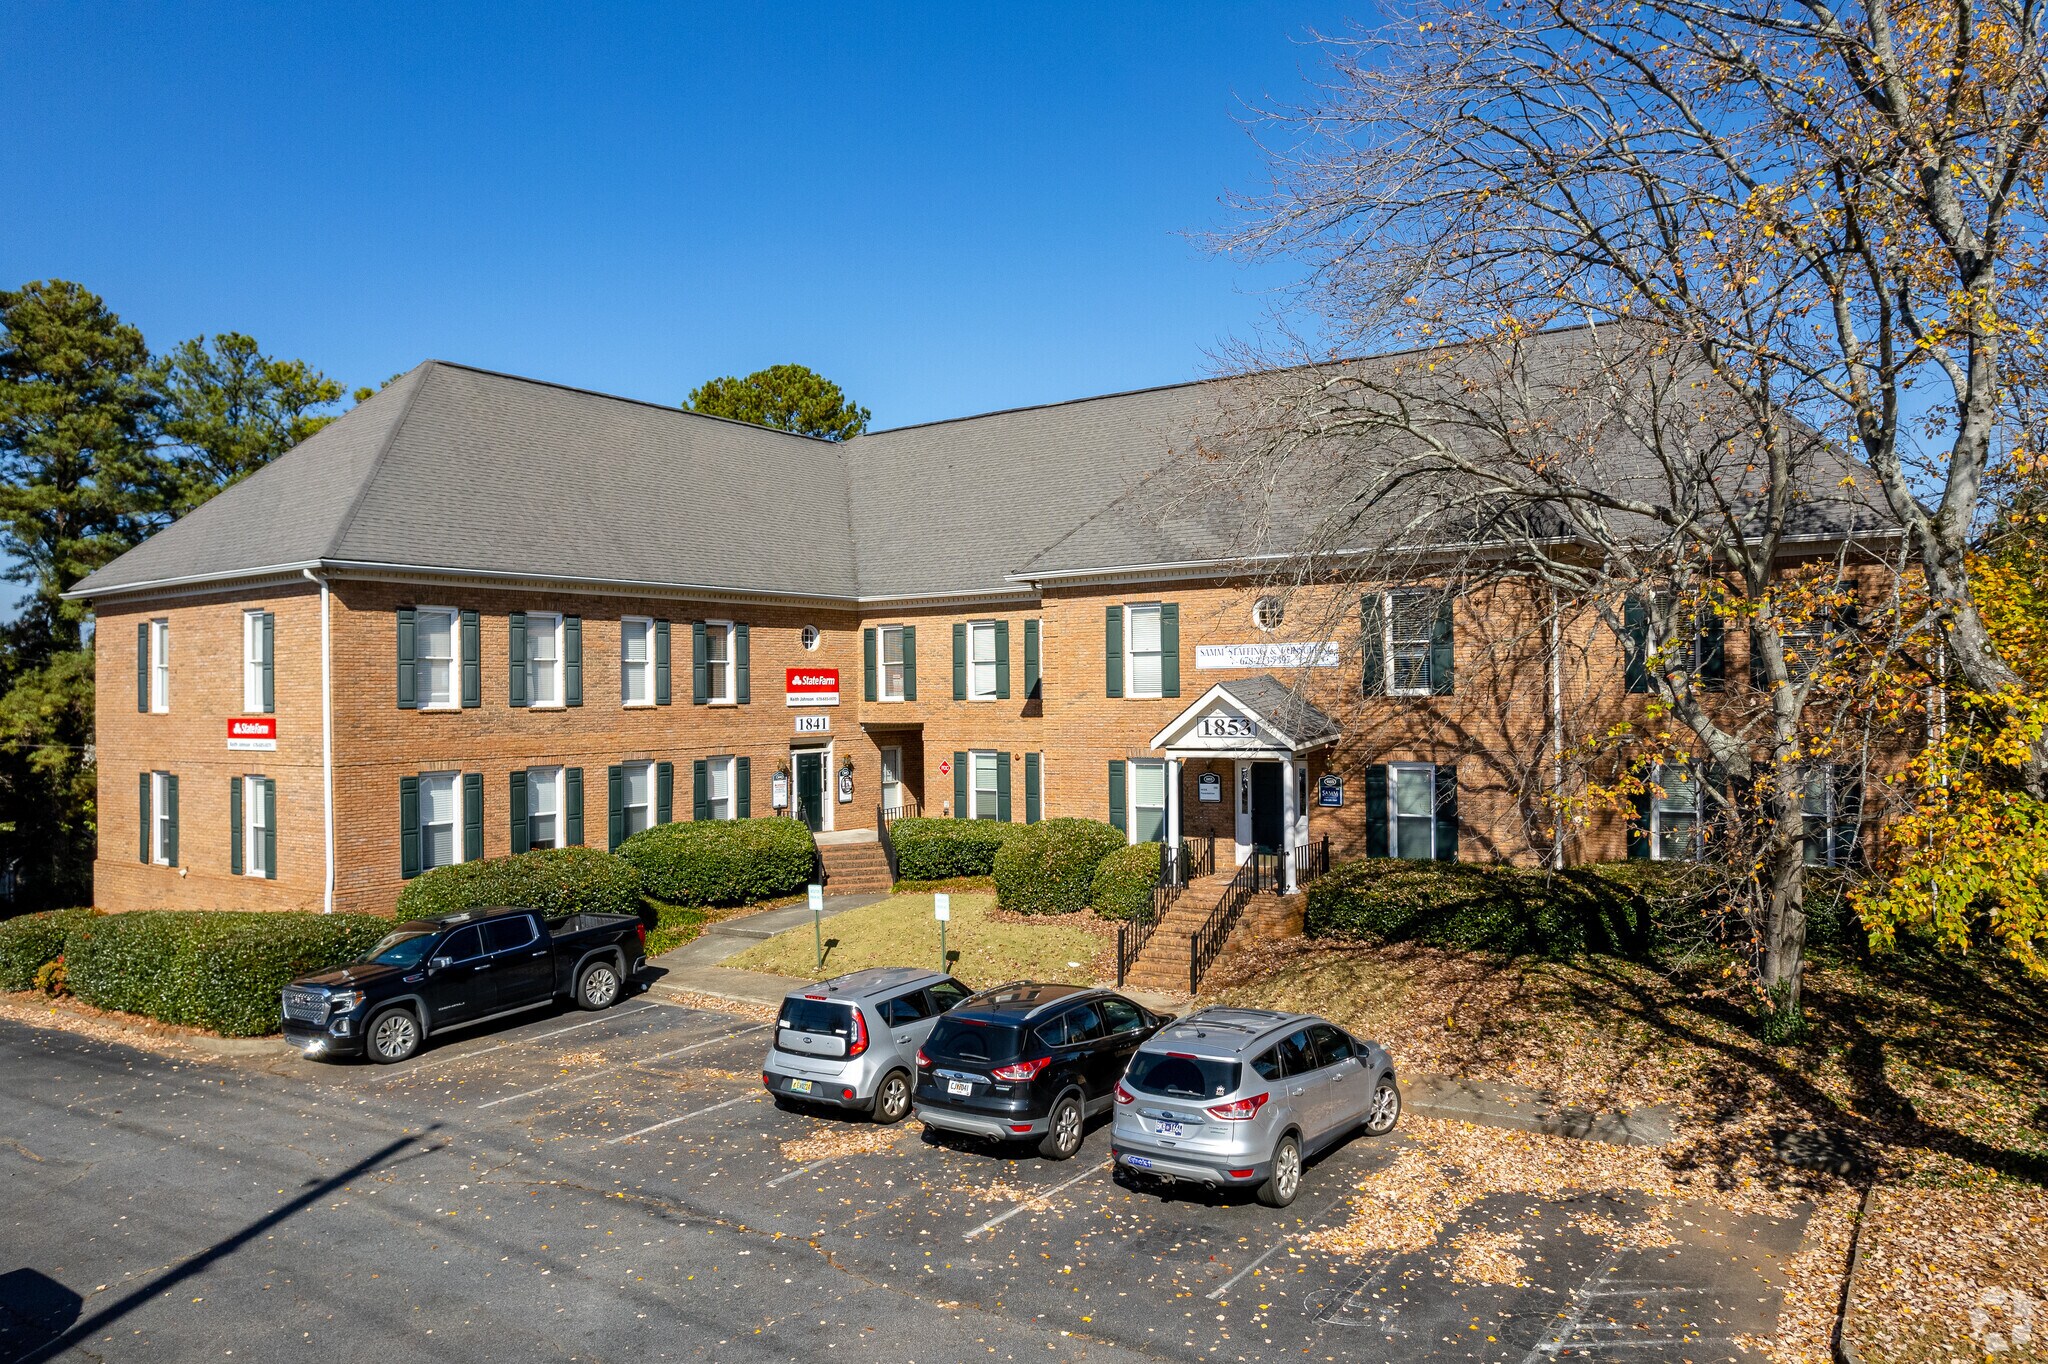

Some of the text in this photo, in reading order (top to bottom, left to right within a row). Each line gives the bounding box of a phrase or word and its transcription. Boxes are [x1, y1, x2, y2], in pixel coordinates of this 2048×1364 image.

[1200, 648, 1224, 656] SAMM
[799, 717, 826, 731] 1841
[1203, 718, 1252, 736] 1853
